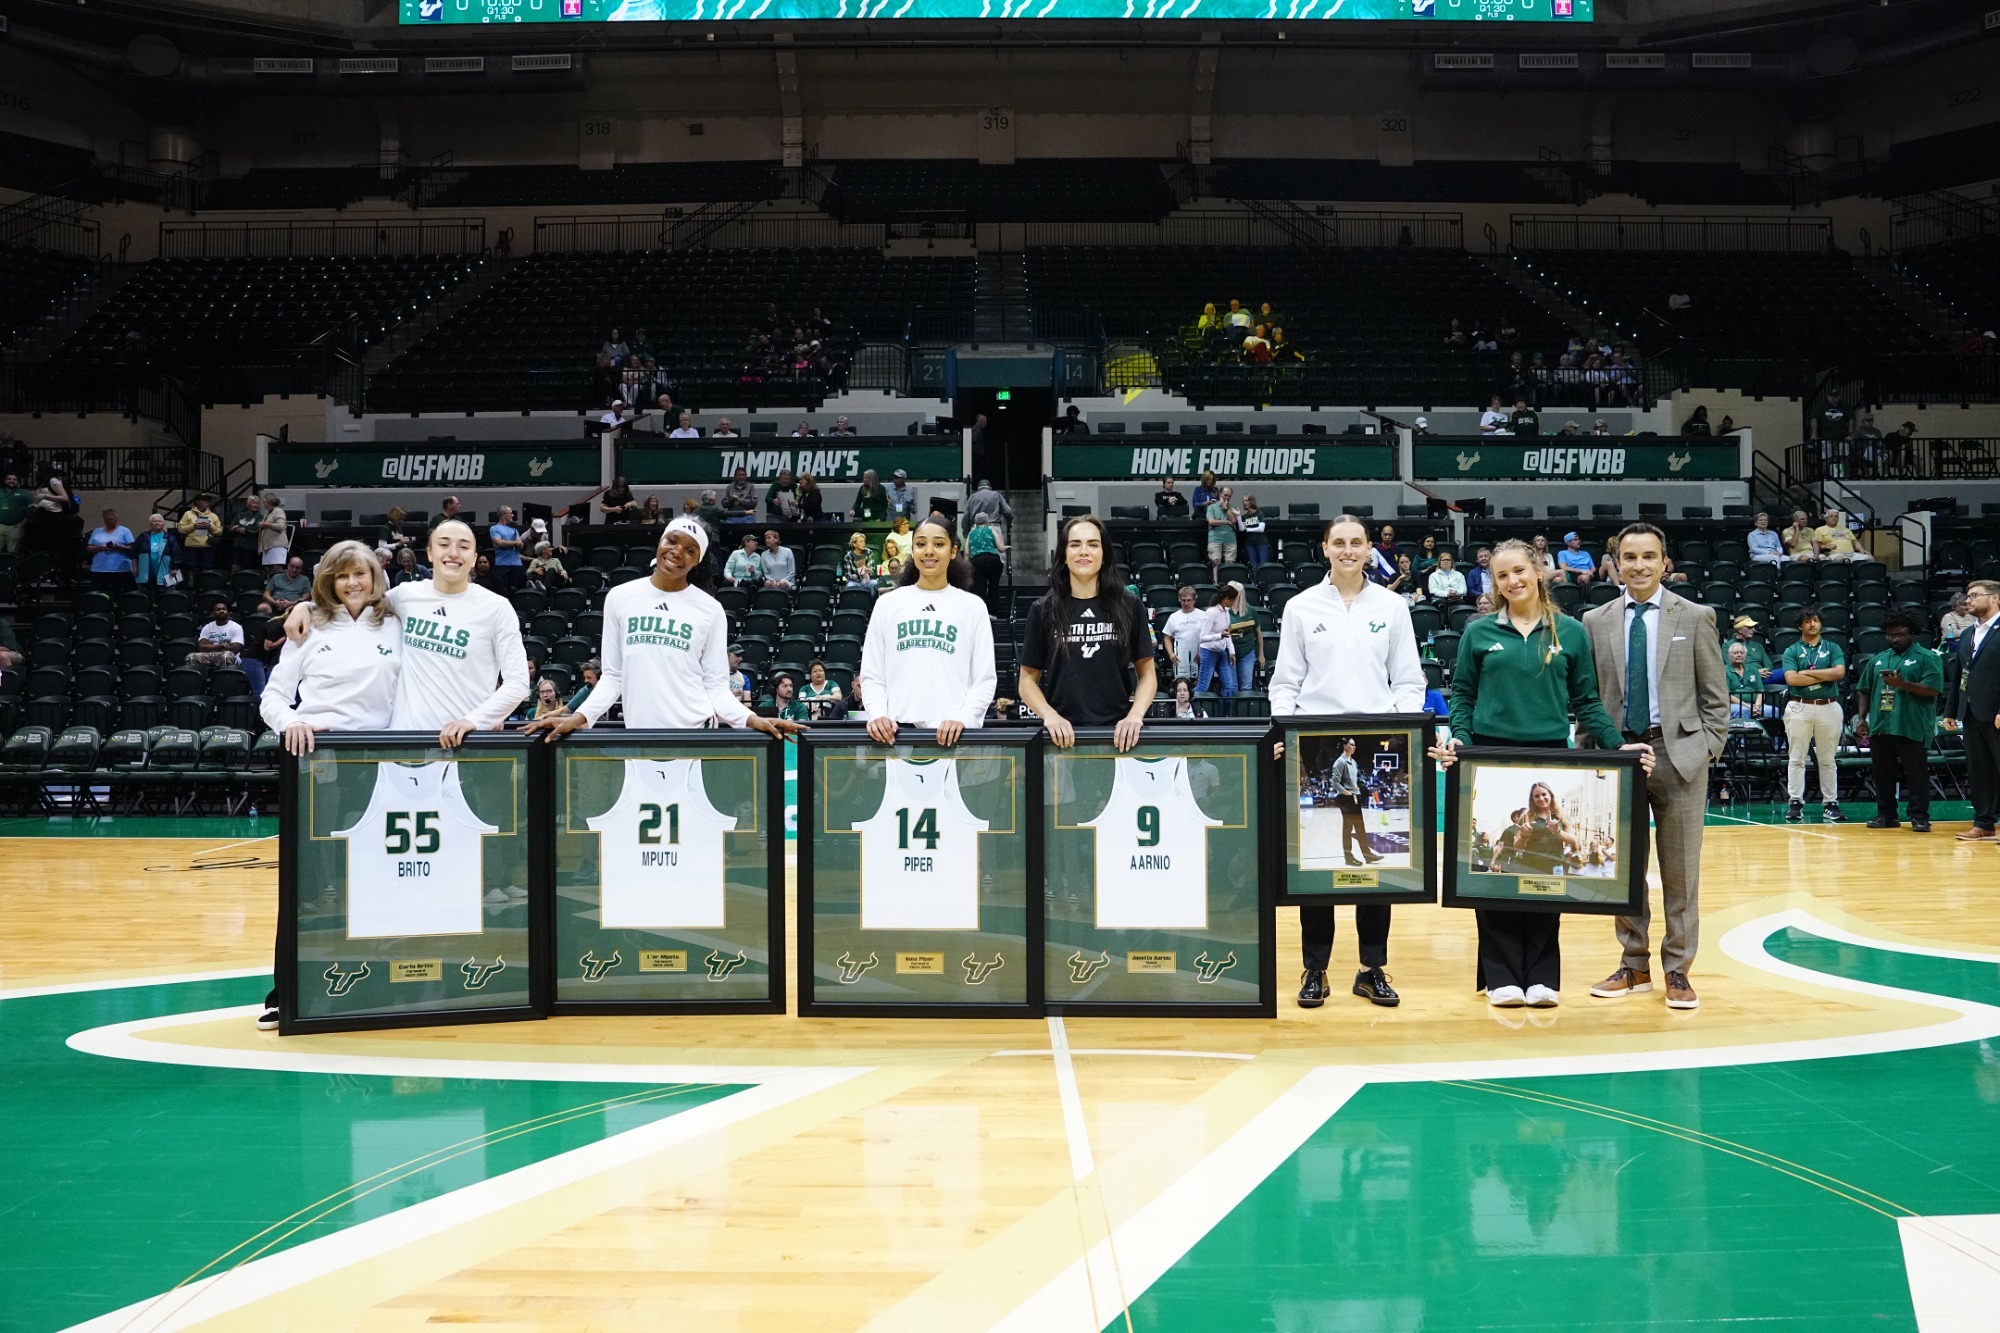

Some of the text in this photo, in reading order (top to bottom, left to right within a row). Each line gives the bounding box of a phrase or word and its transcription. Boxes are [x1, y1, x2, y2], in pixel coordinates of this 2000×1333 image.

[1949, 87, 1981, 107] 322
[585, 122, 610, 136] 318
[983, 116, 1009, 130] 319
[1382, 118, 1407, 132] 320
[291, 132, 316, 145] 317
[1674, 127, 1697, 141] 321
[923, 364, 945, 381] 21
[382, 454, 485, 481] @USFMBB
[721, 450, 860, 478] TAMPA BAY'S
[1131, 448, 1316, 475] HOME FOR HOOPS
[1523, 448, 1626, 475] @USFWBB
[405, 616, 470, 648] BULLS
[627, 616, 693, 640] BULLS
[896, 618, 958, 641] BULLS
[1086, 622, 1118, 636] FLORI
[404, 634, 468, 660] BASKETBALL
[626, 634, 692, 652] BASKETBALL
[896, 637, 956, 655] BASKETBALL
[384, 810, 441, 855] 55
[638, 802, 680, 845] 21
[895, 807, 941, 850] 14
[1136, 805, 1160, 847] 9
[642, 851, 678, 867] MPUTU
[904, 856, 933, 872] PIPER
[1130, 854, 1171, 870] AARNIO
[398, 861, 431, 877] BRITO
